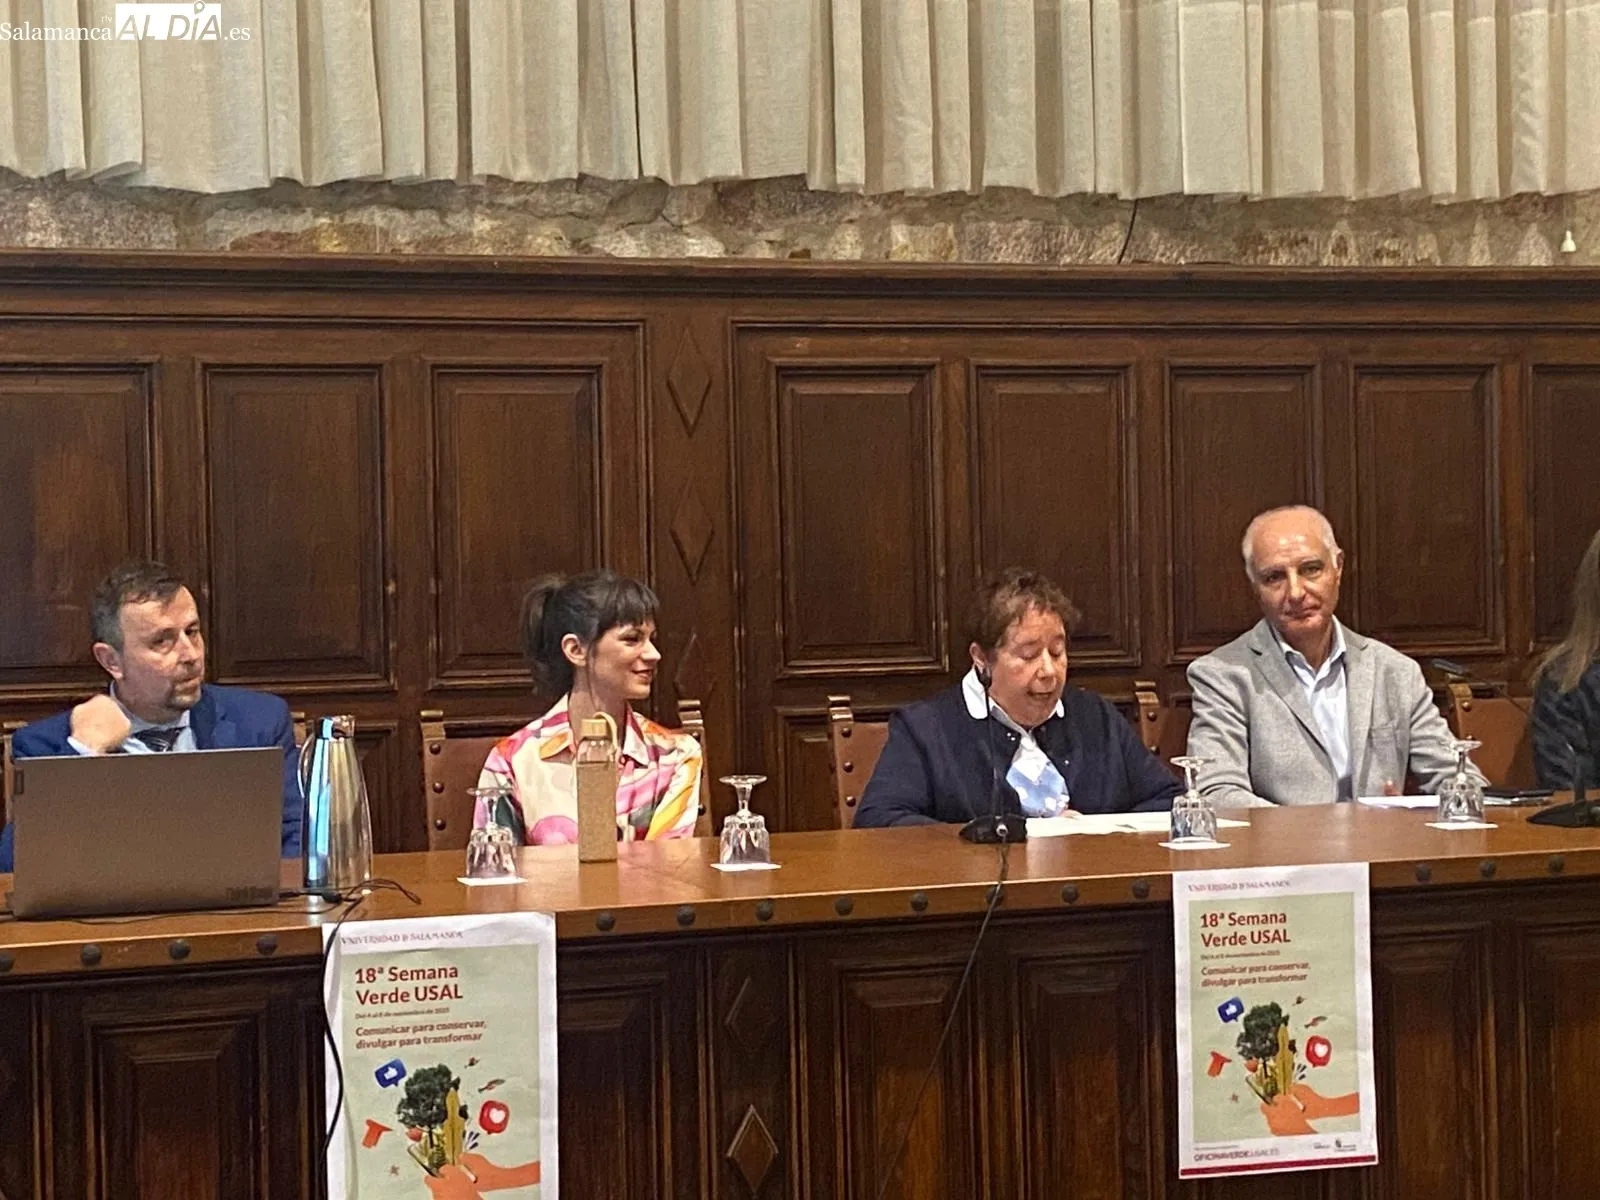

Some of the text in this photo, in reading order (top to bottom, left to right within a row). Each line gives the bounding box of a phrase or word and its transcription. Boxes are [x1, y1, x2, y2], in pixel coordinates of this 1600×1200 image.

[1228, 912, 1287, 926] Semana
[1201, 929, 1291, 947] Verde USAL
[387, 966, 459, 982] Semana
[356, 983, 464, 1006] Verde USAL
[355, 1024, 410, 1037] Comunicar
[412, 1023, 434, 1034] para
[355, 1033, 483, 1050] divulgar para transformar
